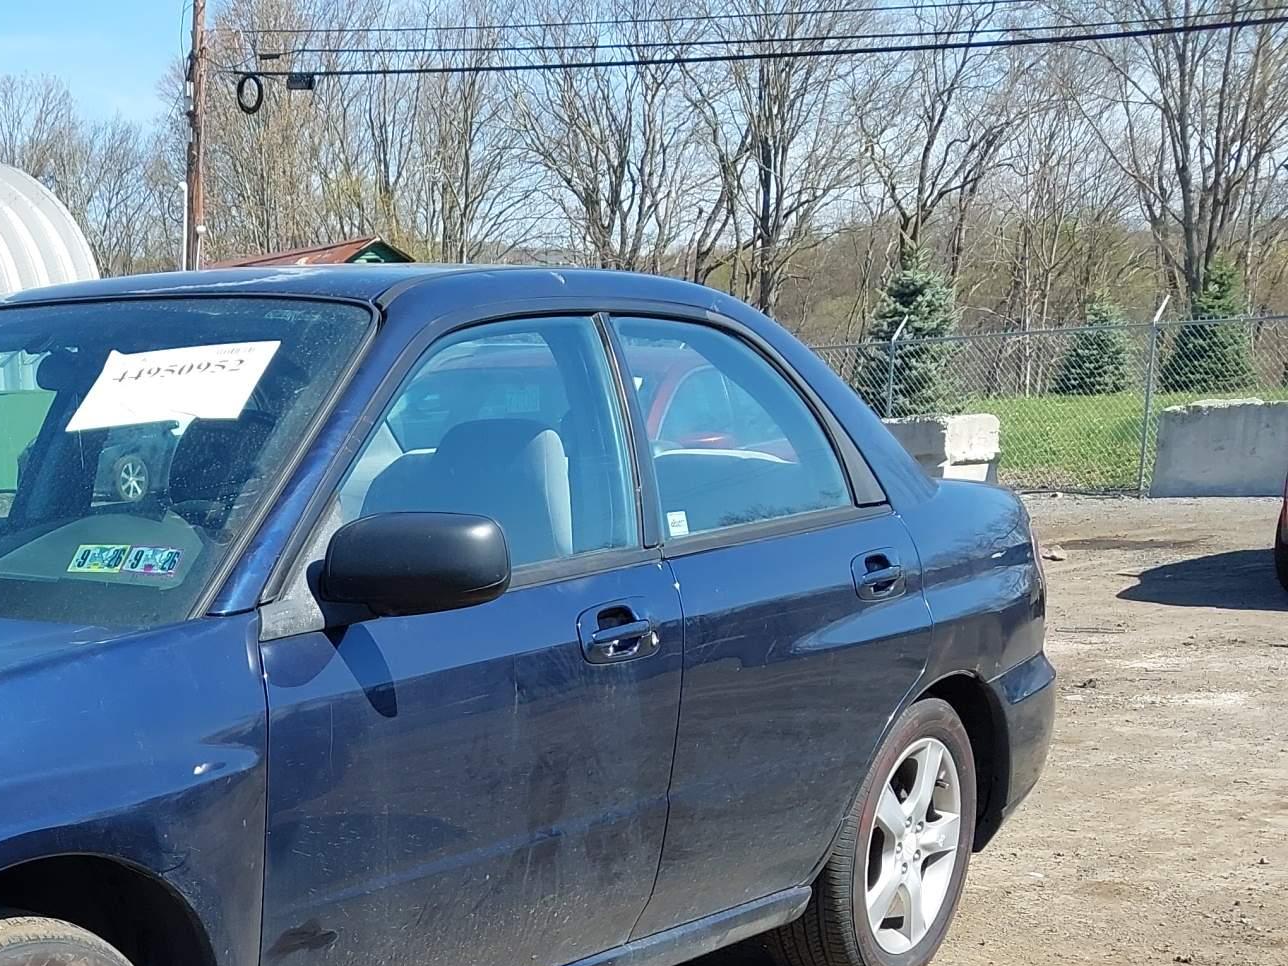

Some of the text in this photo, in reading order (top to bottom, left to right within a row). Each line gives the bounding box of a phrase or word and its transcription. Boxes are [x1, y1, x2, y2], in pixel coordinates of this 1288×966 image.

[112, 359, 245, 383] 44950952
[77, 549, 91, 569] 9
[130, 550, 144, 569] 9
